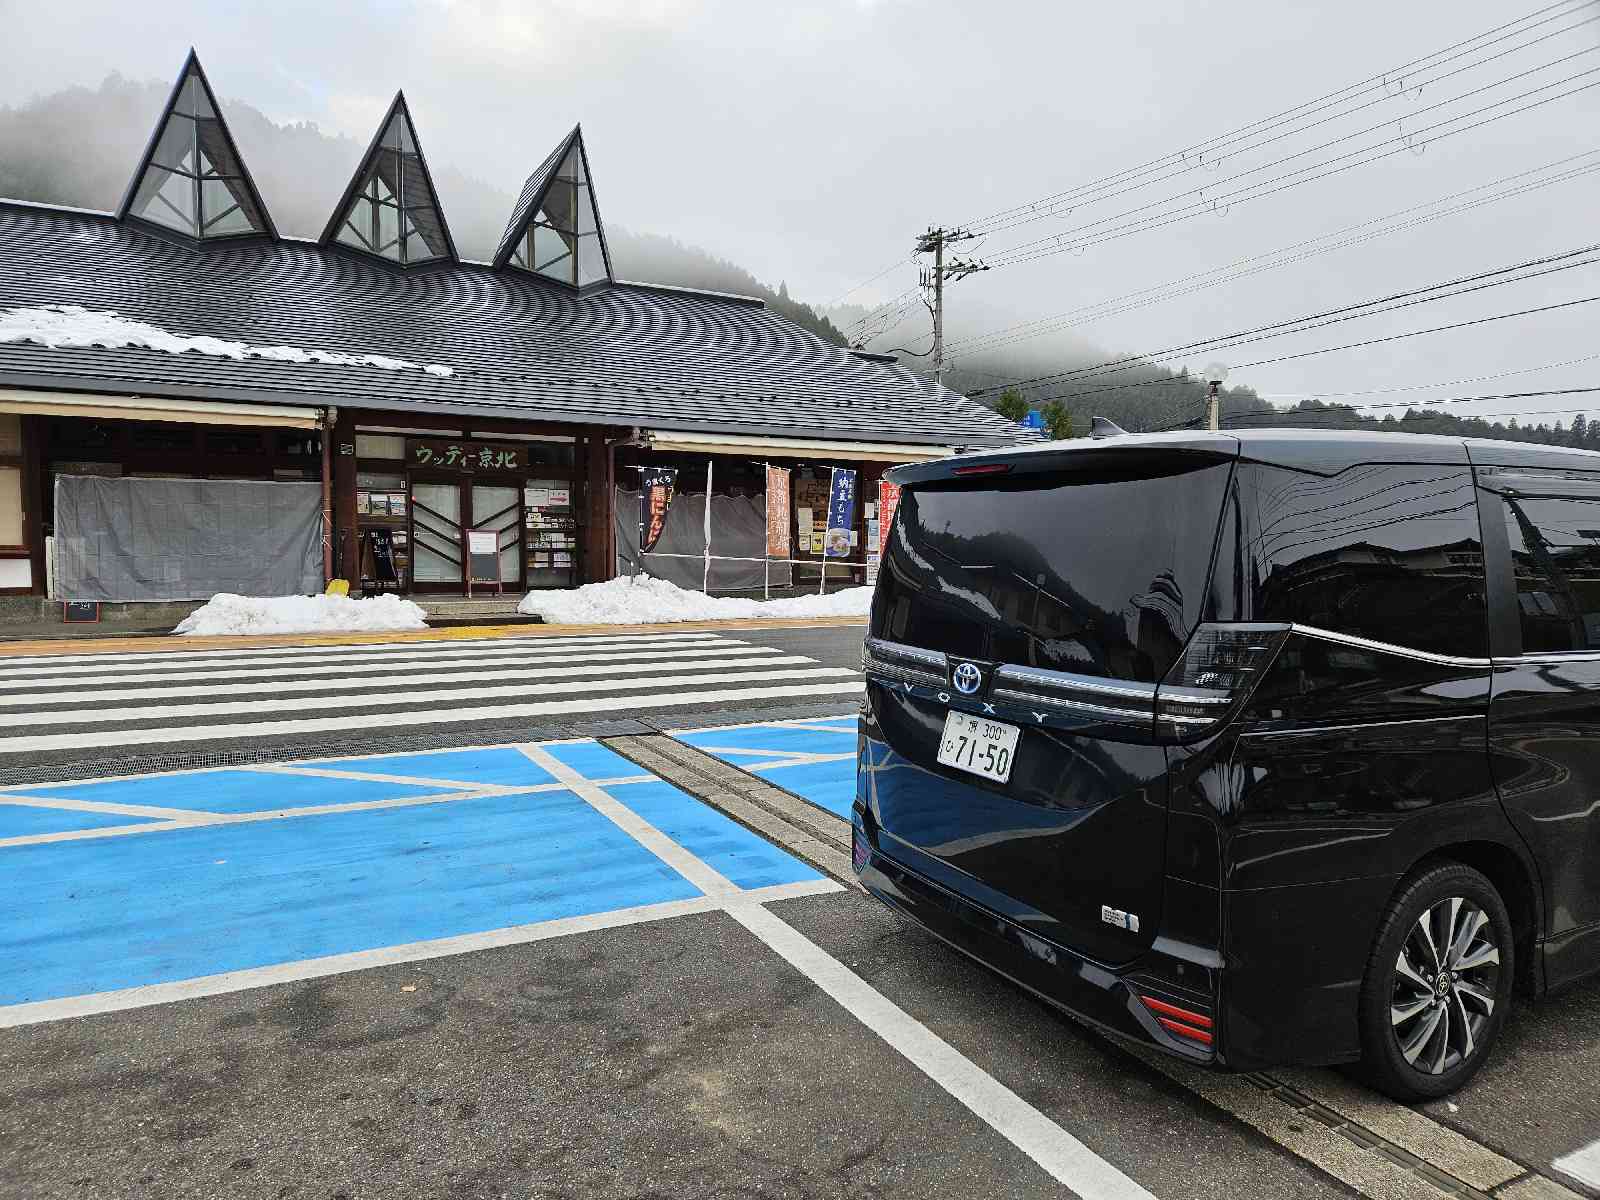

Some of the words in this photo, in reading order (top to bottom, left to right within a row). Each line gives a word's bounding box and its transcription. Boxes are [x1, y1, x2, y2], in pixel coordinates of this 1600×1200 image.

[903, 681, 1049, 724] VOXY
[982, 723, 1002, 741] 300
[955, 735, 1009, 776] 71-50
